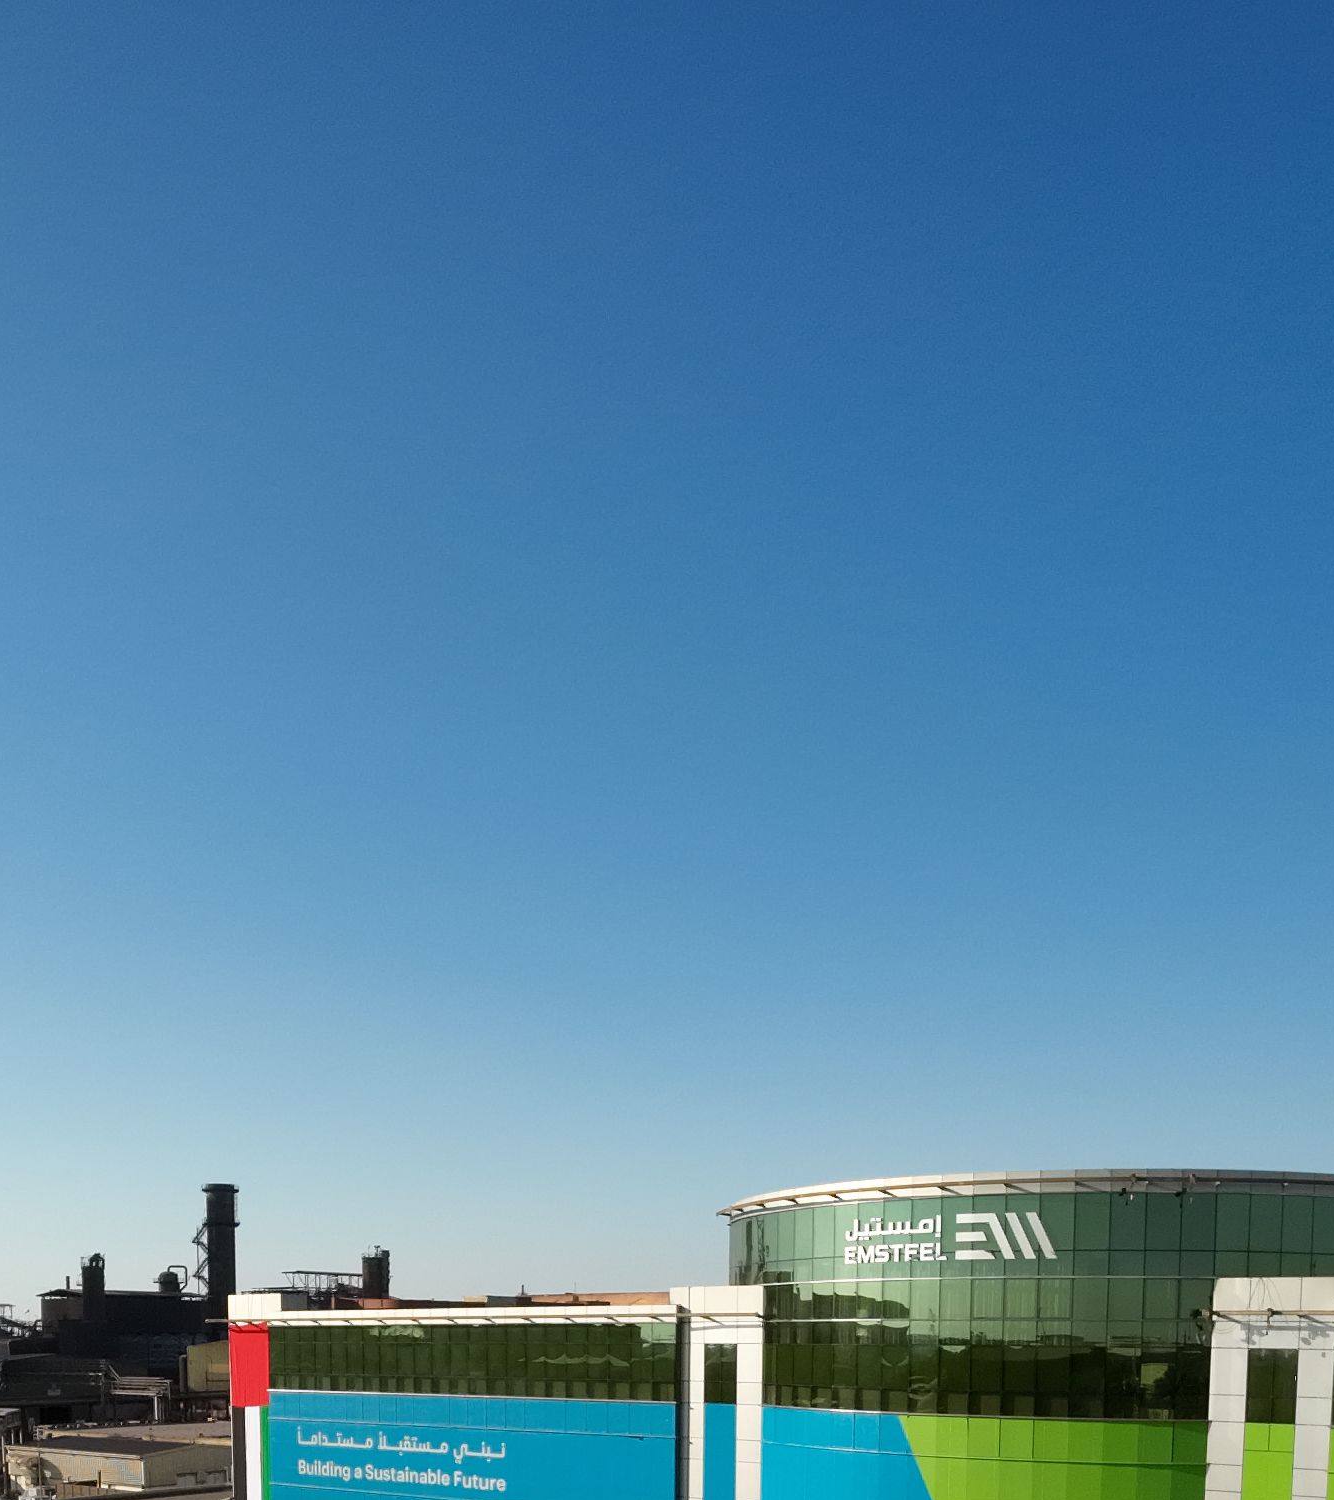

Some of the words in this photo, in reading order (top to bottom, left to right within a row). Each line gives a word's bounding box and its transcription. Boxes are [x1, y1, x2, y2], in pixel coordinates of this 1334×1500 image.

[845, 1214, 942, 1241] إمستيل
[844, 1242, 947, 1264] EMSTEEL
[453, 1441, 506, 1464] نبني
[298, 1459, 351, 1482] Building
[354, 1467, 363, 1479] a
[365, 1463, 451, 1487] Sustainable
[453, 1470, 506, 1492] Future
